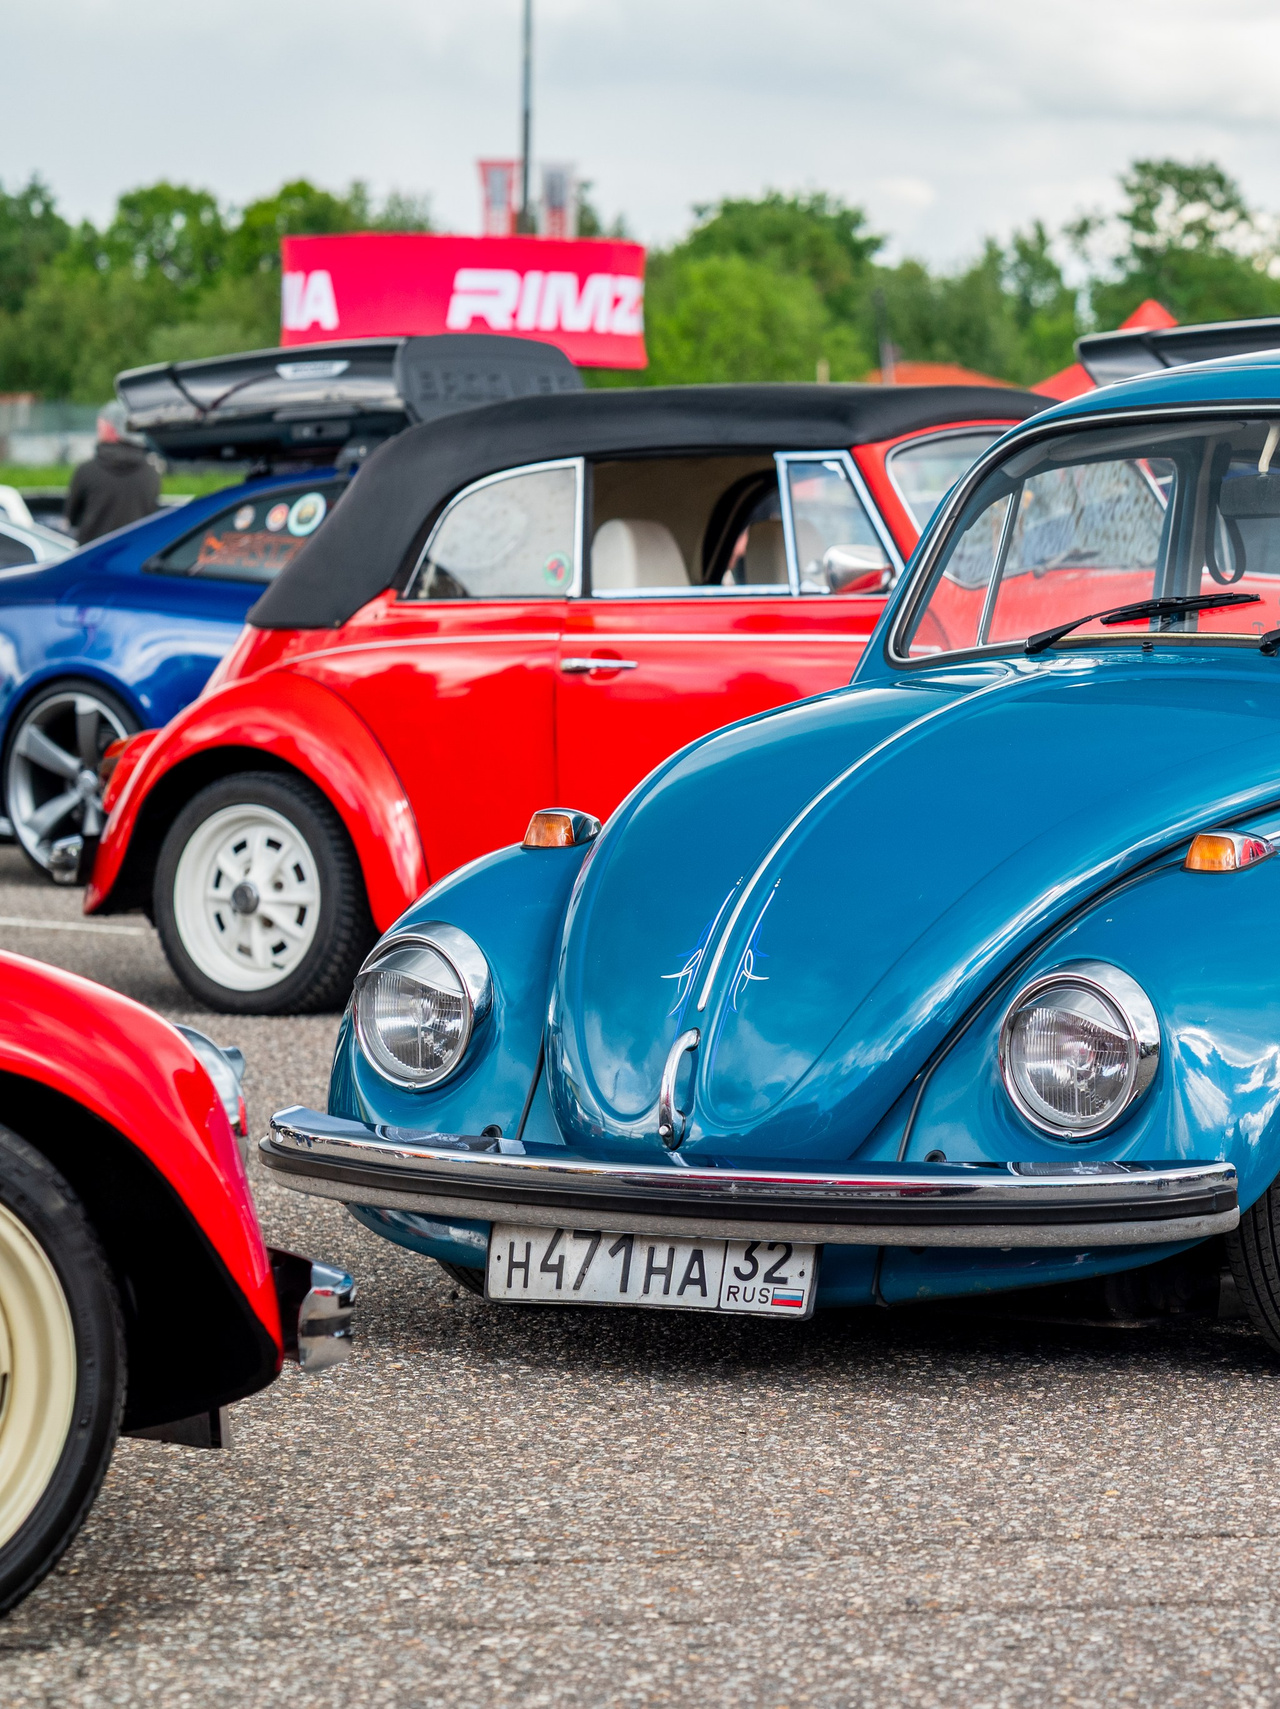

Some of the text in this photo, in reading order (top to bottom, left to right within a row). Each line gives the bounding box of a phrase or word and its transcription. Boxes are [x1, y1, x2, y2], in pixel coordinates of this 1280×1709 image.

[507, 1228, 708, 1298] H471HA
[733, 1241, 793, 1285] 32
[726, 1285, 771, 1304] RUS
